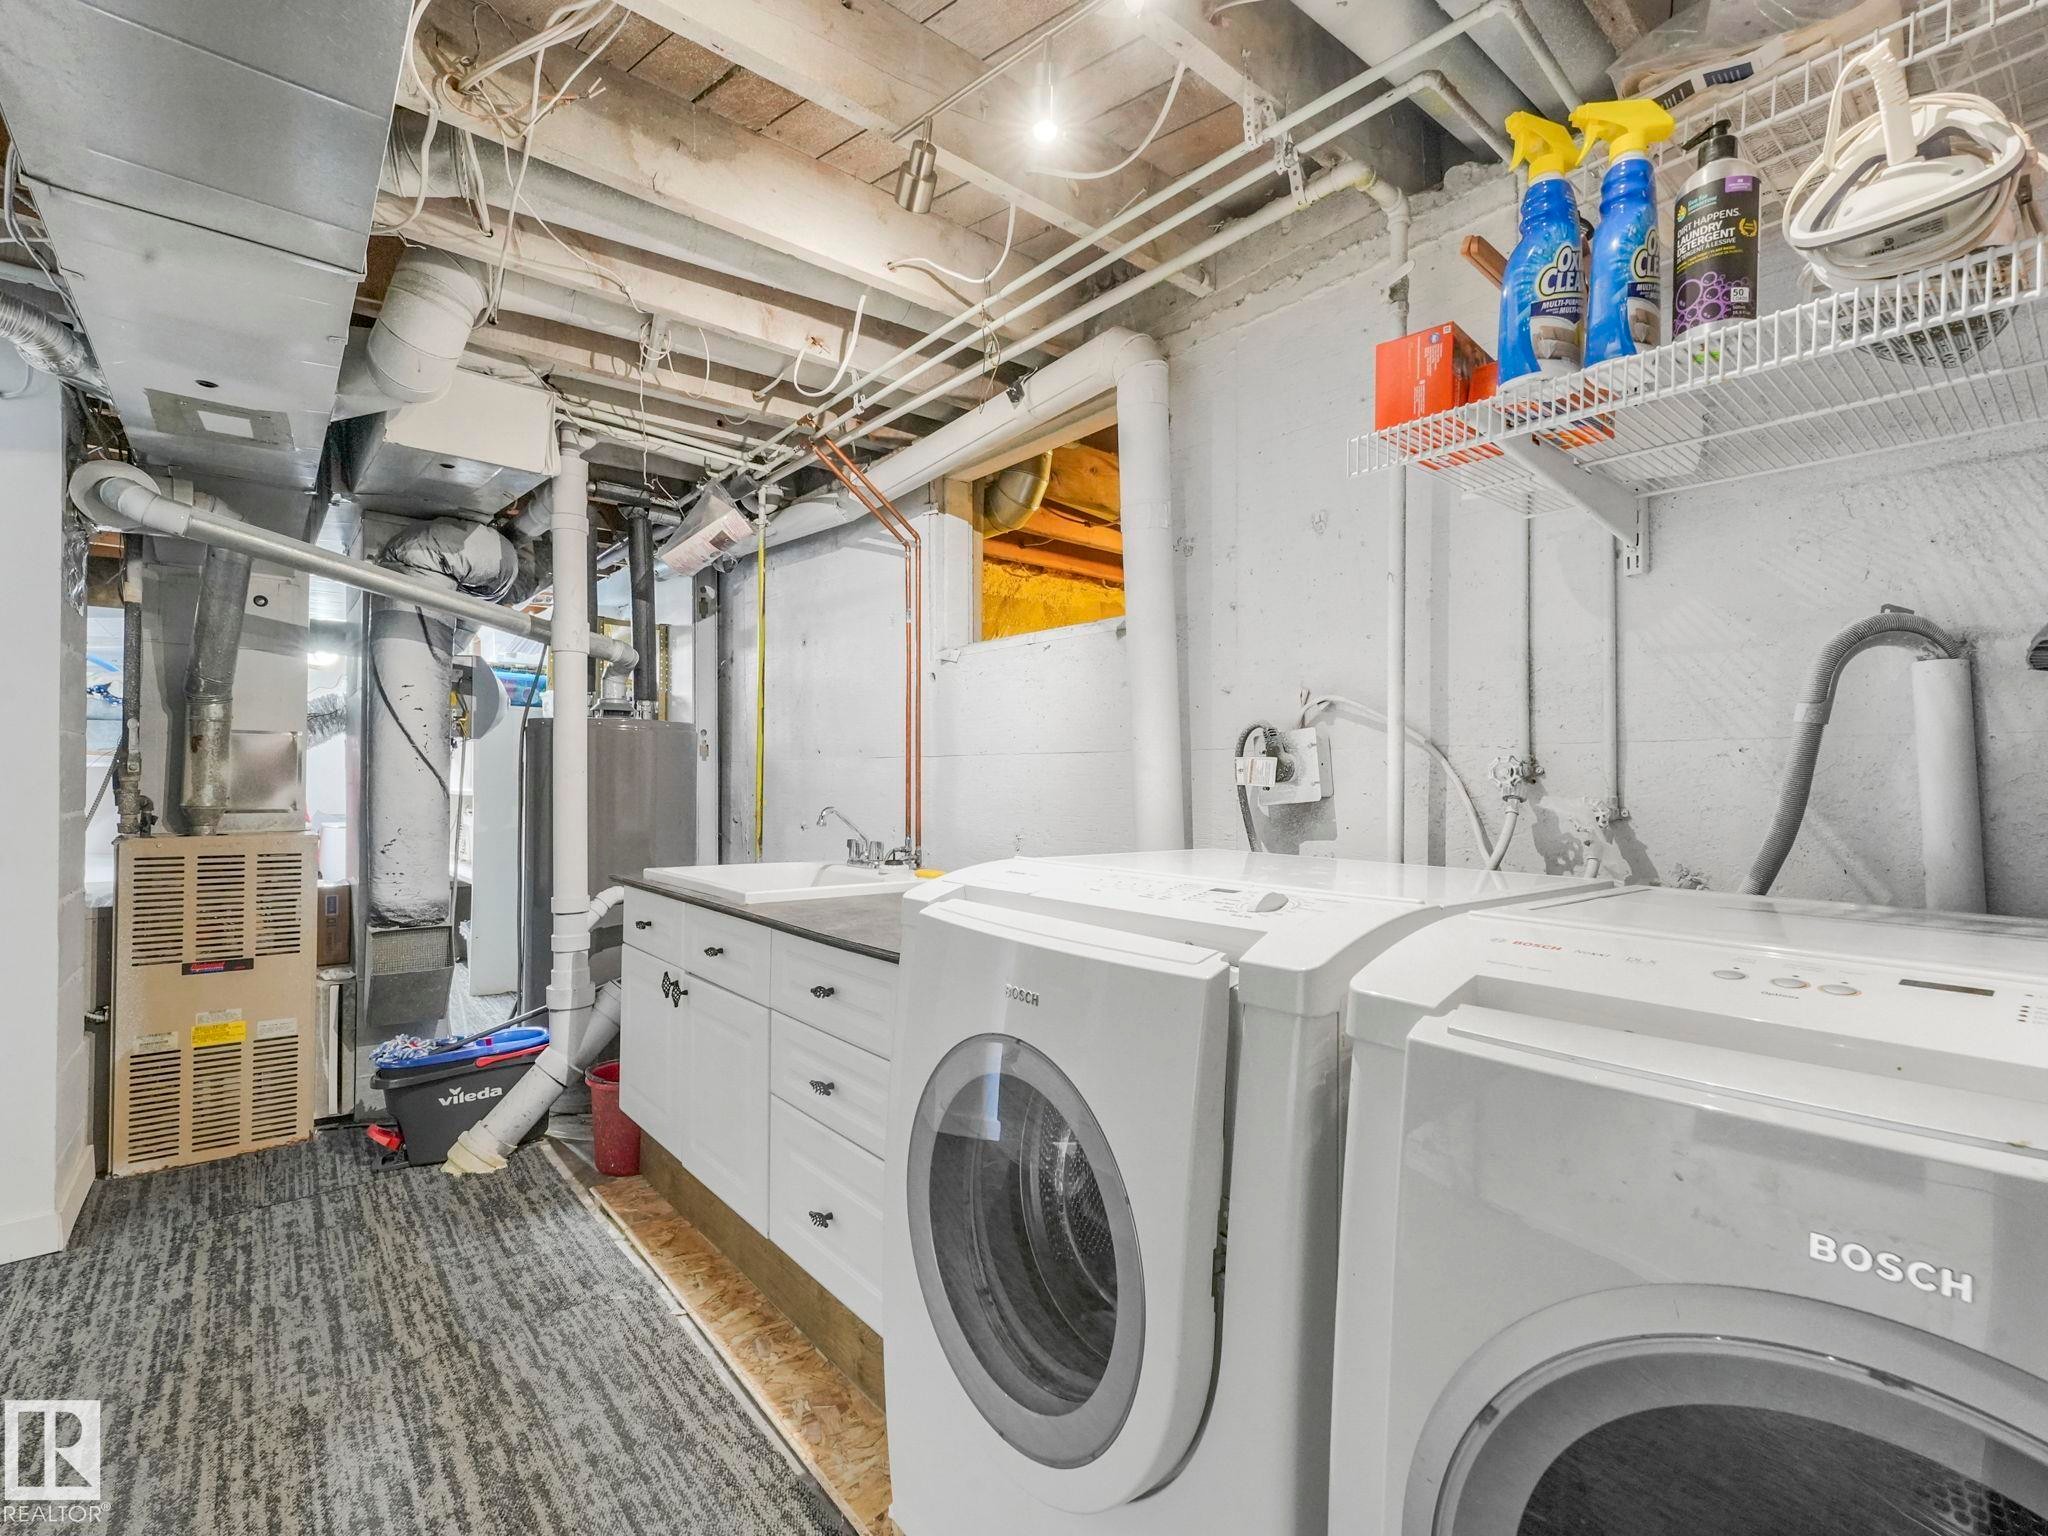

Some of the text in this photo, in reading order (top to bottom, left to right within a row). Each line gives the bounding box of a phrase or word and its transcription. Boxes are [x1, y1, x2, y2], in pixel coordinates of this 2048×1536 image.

[1677, 222, 1692, 239] DIRT
[1693, 207, 1739, 228] HAPPENS
[1677, 220, 1723, 248] LAUNDRY
[1677, 227, 1736, 258] DETERGENT
[1733, 288, 1744, 296] 50
[1512, 940, 1562, 951] BOSCH
[1002, 984, 1039, 1007] BOSCH
[438, 1086, 503, 1106] vileda
[1809, 1231, 1973, 1304] BOSCH
